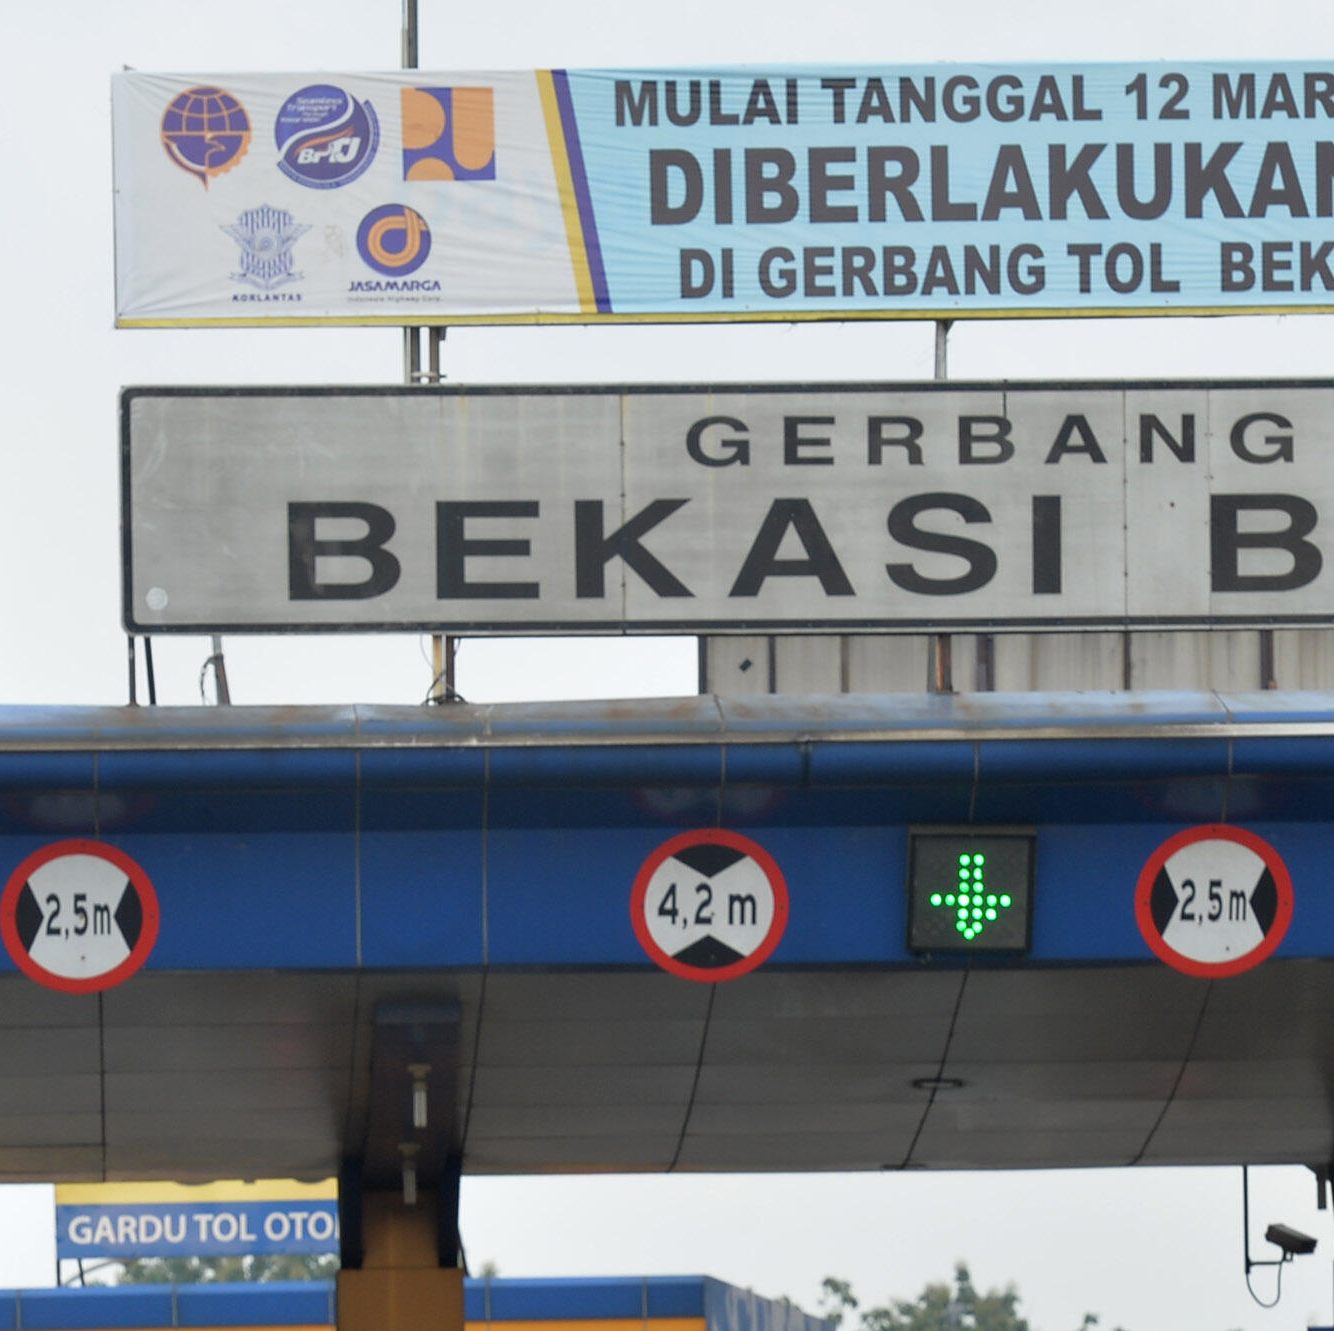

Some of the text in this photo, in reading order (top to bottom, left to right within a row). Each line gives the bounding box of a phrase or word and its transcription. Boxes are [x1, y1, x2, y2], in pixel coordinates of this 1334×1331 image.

[614, 78, 798, 127] MULAI
[831, 72, 1103, 123] TANGGAL
[1123, 72, 1191, 121] 12
[348, 280, 441, 292] JASAMARGA
[679, 248, 731, 299] DI
[756, 243, 1048, 299] GERBANG
[1065, 241, 1181, 295] TOL
[685, 411, 1296, 467] GERBANG
[287, 492, 1063, 601] BEKASI
[658, 883, 712, 930] 4,2
[68, 1214, 187, 1245] GARDU
[193, 1213, 256, 1242] TOL
